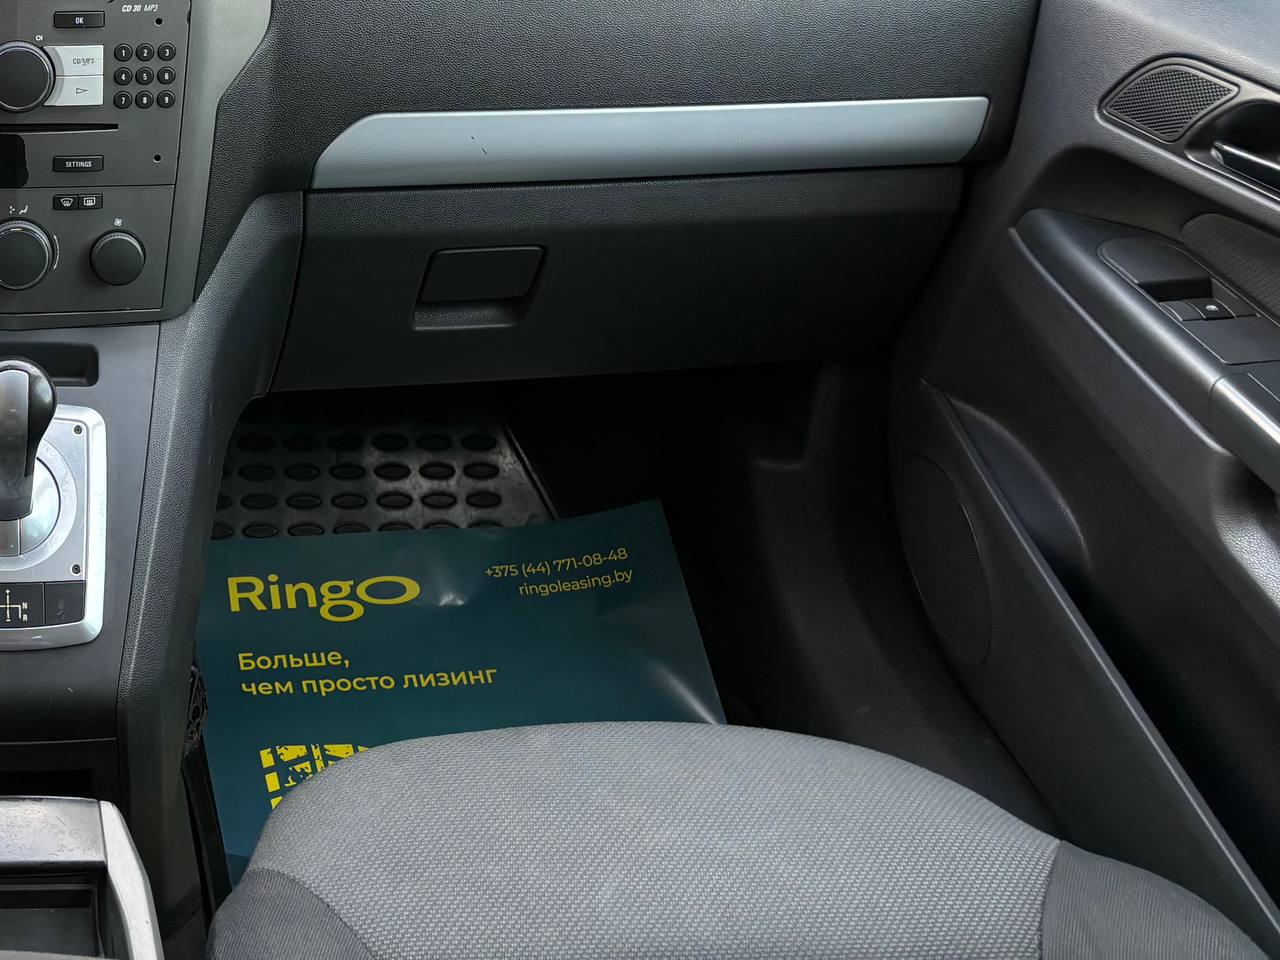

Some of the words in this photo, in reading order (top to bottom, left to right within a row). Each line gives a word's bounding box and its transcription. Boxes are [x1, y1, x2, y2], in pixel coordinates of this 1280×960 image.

[122, 4, 132, 12] CD
[132, 4, 141, 12] 30
[143, 4, 159, 12] MP3
[72, 58, 95, 66] CD/MP3
[65, 160, 93, 169] SETTINGS
[485, 564, 519, 578] +375
[521, 560, 551, 578] (44)
[553, 548, 628, 573] 771-08-48
[518, 569, 633, 597] ringoleasing.by
[22, 602, 28, 610] N
[22, 614, 28, 622] R
[238, 648, 351, 672] Больше,
[241, 677, 295, 696] чем
[301, 671, 396, 698] просто
[403, 668, 498, 690] лизинг
